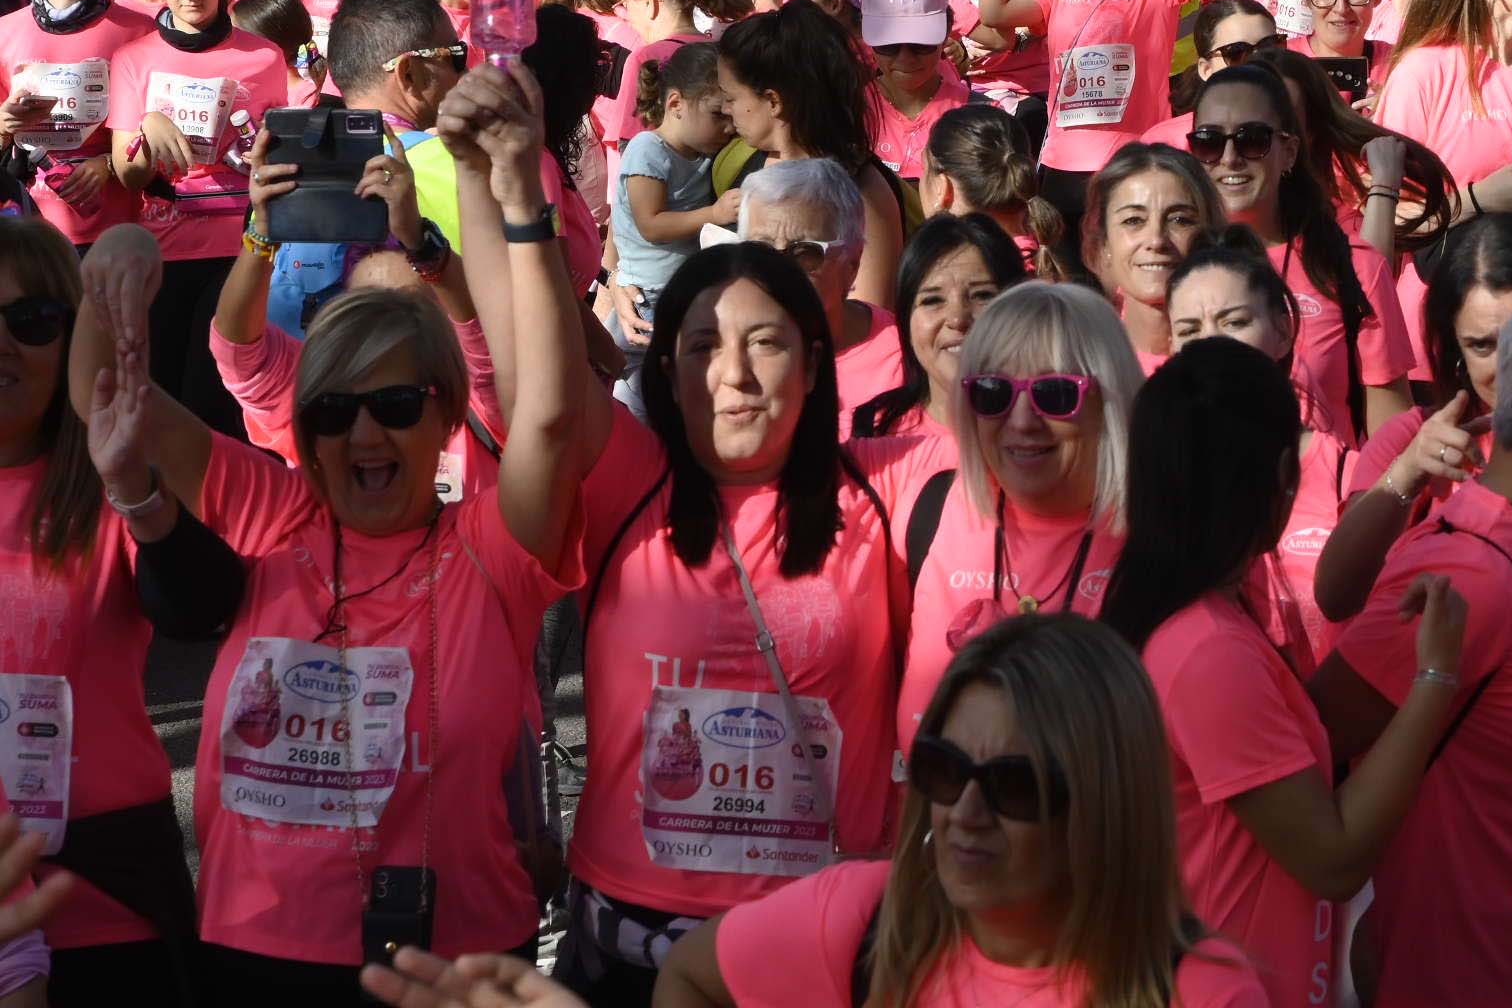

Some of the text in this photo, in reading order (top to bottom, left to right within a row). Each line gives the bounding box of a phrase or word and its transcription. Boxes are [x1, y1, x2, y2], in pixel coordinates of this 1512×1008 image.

[1080, 75, 1106, 89] 016
[57, 96, 77, 110] 16
[51, 113, 73, 121] 3909
[178, 108, 209, 123] 016
[18, 699, 59, 711] SUMA
[285, 713, 351, 743] 016
[708, 720, 780, 740] ASTURIANA
[287, 747, 341, 767] 26988
[291, 771, 309, 782] DE
[309, 773, 324, 783] LA
[708, 762, 775, 790] 016
[233, 786, 287, 808] OYSHO
[712, 796, 766, 814] 26994
[658, 816, 714, 830] CARRERA
[716, 821, 732, 832] DE
[734, 822, 750, 832] LA
[752, 823, 791, 834] MUJER
[653, 839, 713, 858] OYSHO
[763, 848, 820, 863] Santander
